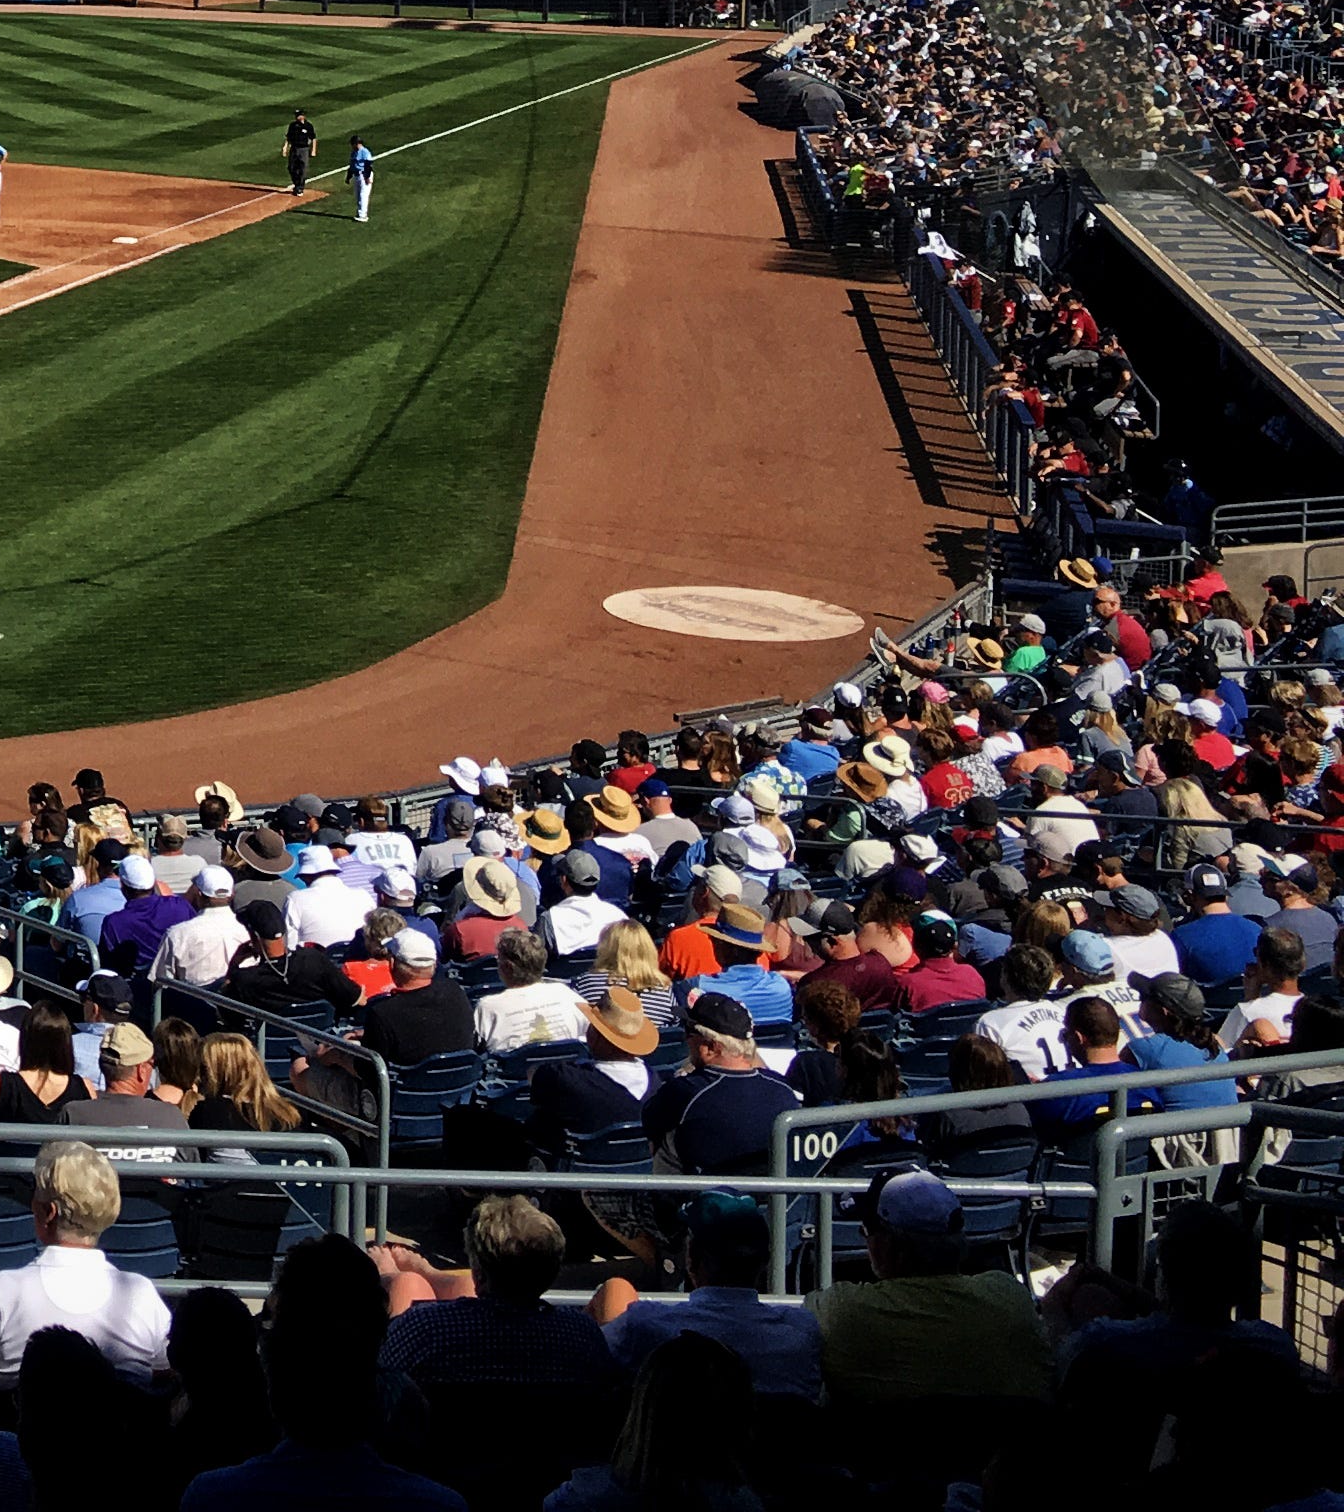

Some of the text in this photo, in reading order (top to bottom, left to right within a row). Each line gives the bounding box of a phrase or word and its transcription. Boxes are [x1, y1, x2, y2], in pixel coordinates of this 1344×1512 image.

[365, 843, 402, 861] CRUZ
[1018, 1008, 1063, 1033] MARTINE
[793, 1131, 838, 1162] 100
